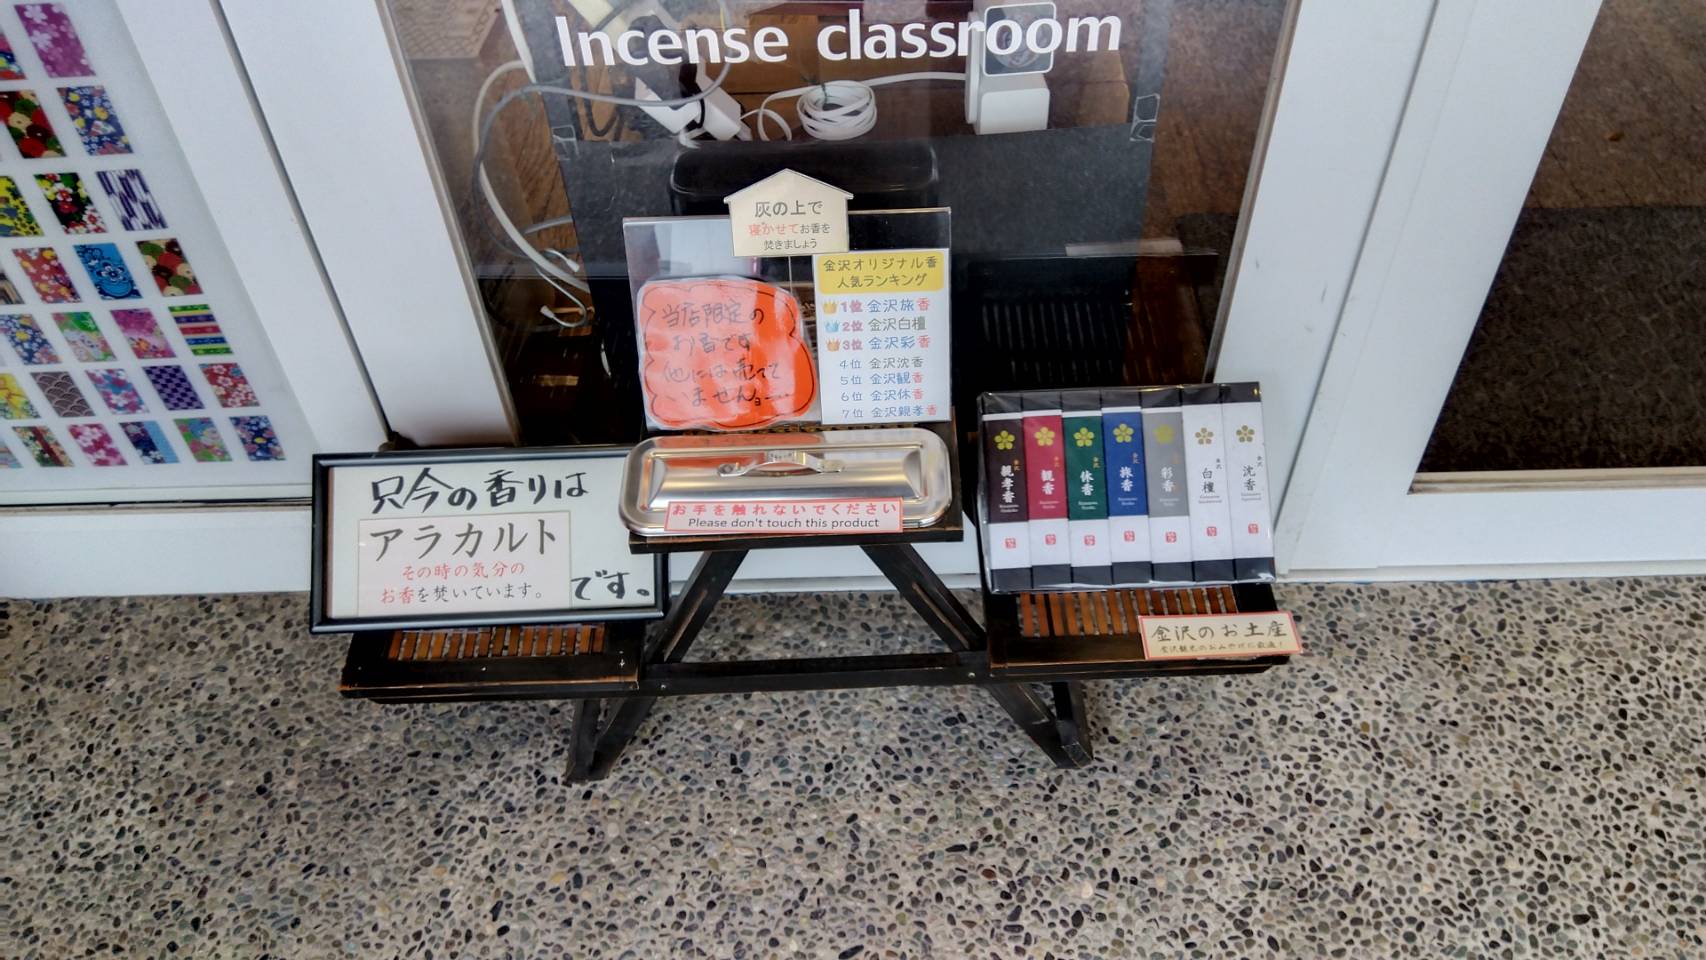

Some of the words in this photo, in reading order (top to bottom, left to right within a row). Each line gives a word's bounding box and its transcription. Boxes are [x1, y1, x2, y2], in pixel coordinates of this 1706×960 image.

[555, 15, 789, 67] Incense
[815, 8, 1123, 62] classroom
[755, 200, 823, 218] 灰の上で
[748, 222, 831, 236] 寝かせてお香を
[764, 239, 817, 250] 焚きましょう
[823, 256, 937, 272] 金沢オリジナル香
[837, 273, 927, 289] 人気ランキング
[662, 298, 764, 327] 当店限定の
[867, 298, 930, 313] 金沢旅香
[868, 316, 926, 332] 金沢白檀
[371, 467, 589, 514] 只今の香りは
[672, 502, 897, 516] お手を触れないでください
[688, 517, 728, 528] Please
[731, 517, 764, 528] don't
[767, 517, 802, 528] touch
[806, 517, 828, 528] this
[831, 517, 879, 529] product
[370, 518, 556, 561] アラカルト
[401, 560, 525, 581] その時の気分の
[380, 581, 543, 605] お香を焚いています。
[571, 569, 650, 601] です。
[1151, 620, 1287, 642] 金沢のお土産
